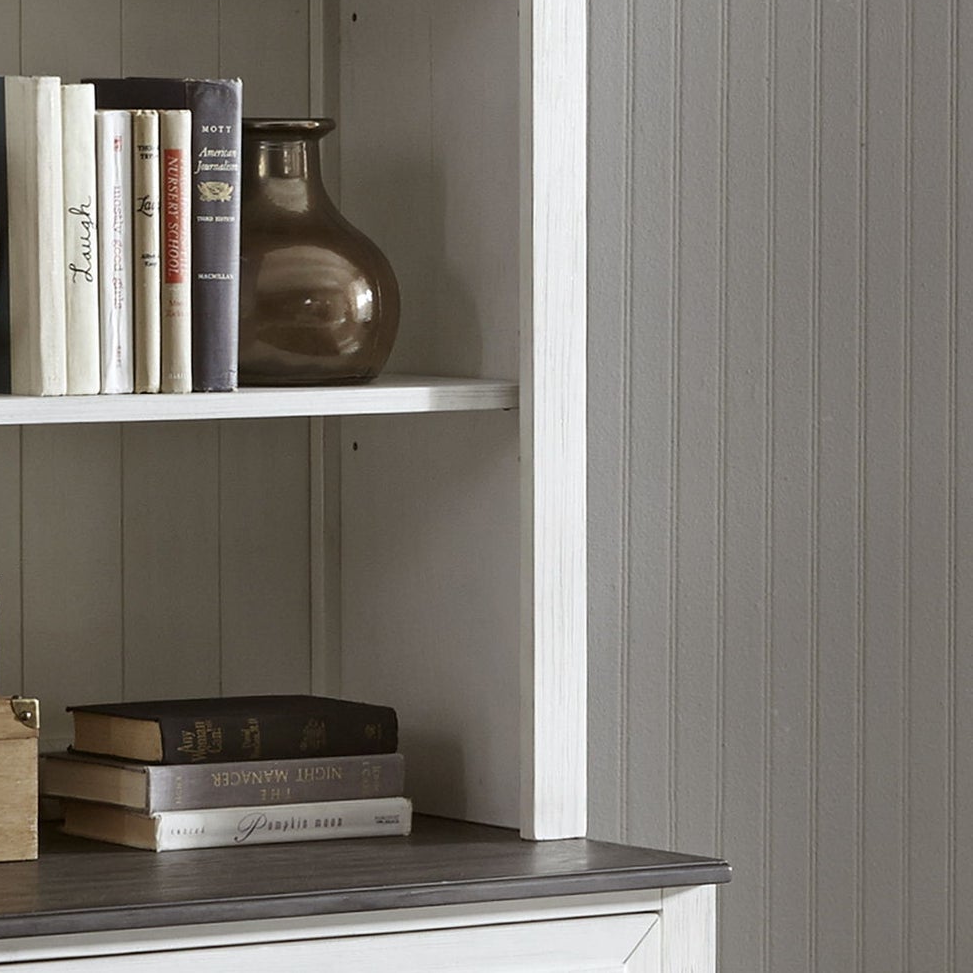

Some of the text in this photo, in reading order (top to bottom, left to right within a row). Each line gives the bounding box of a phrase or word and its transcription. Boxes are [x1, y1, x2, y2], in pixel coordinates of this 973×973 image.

[201, 125, 232, 133] MOTT
[198, 147, 237, 158] American
[193, 160, 238, 174] Journalism
[167, 155, 179, 276] NURSERY SCHOOL
[68, 194, 95, 284] Laugh
[177, 730, 198, 753] Any
[211, 769, 289, 787] MANAGER
[295, 766, 342, 783] NIGHT
[260, 787, 291, 800] THE
